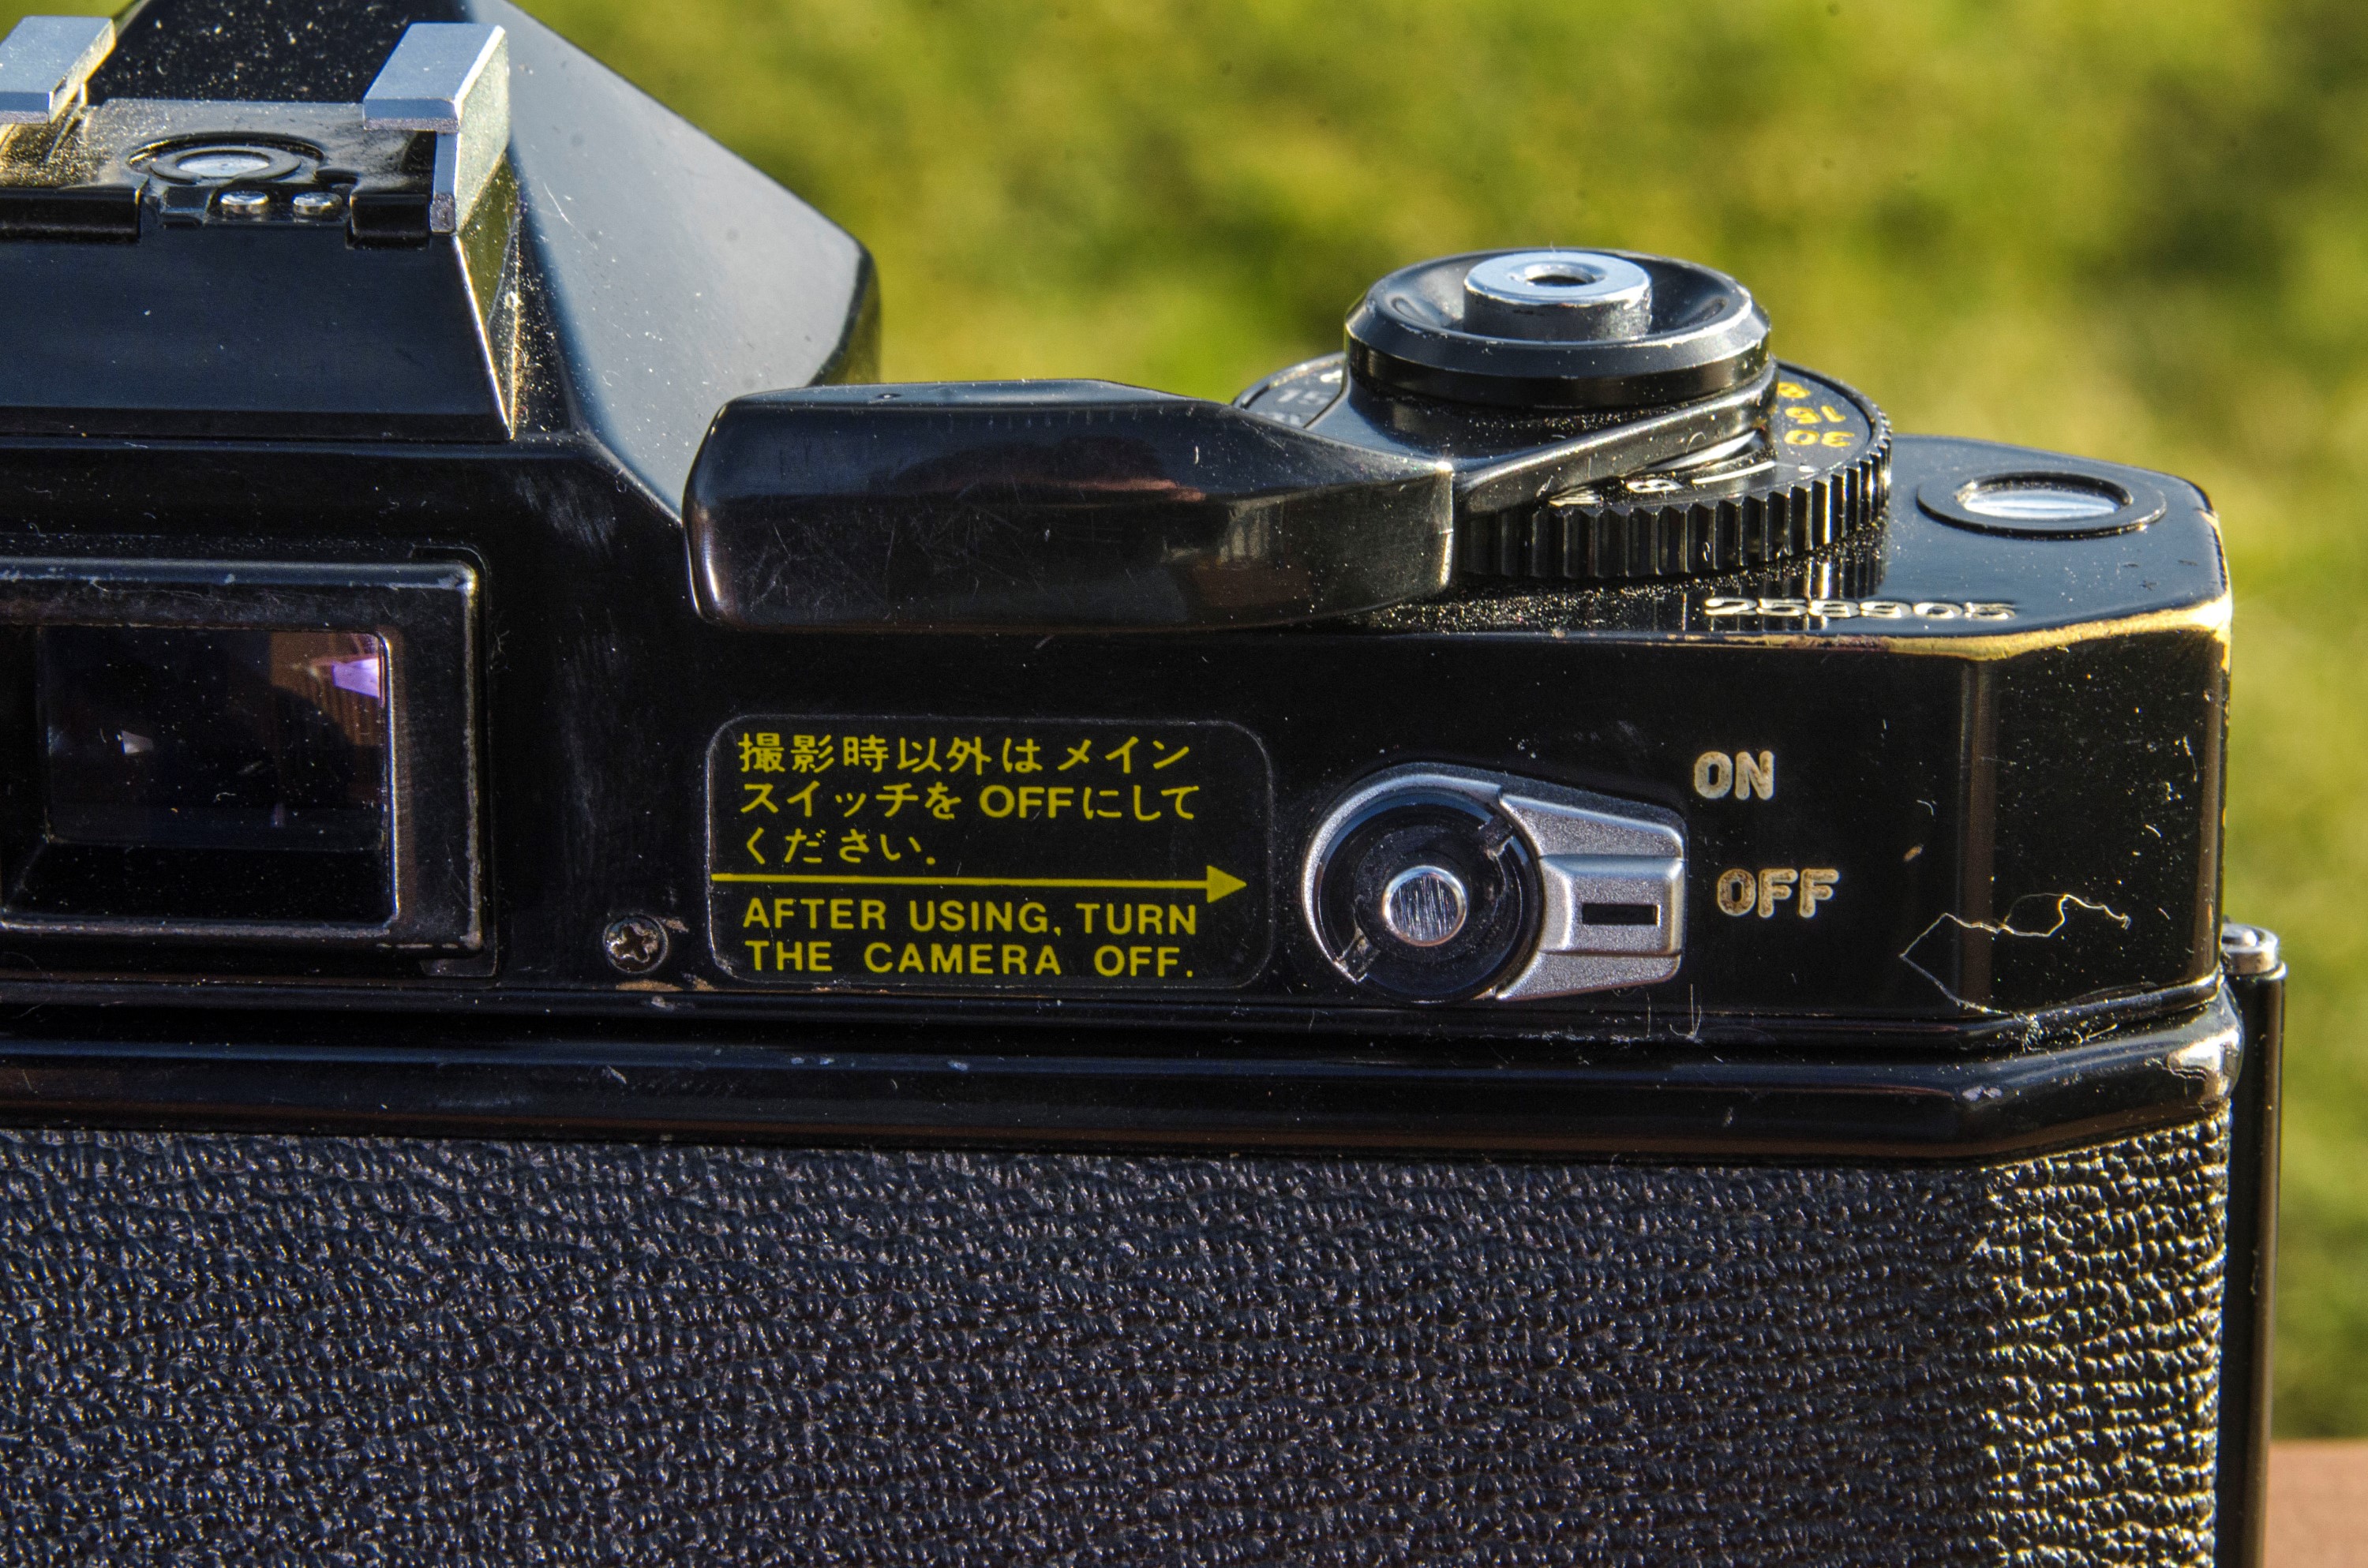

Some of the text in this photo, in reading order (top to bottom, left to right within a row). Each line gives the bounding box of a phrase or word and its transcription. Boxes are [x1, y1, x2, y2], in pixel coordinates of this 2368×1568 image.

[1785, 405, 1847, 425] 15
[1784, 429, 1855, 447] 30
[1703, 597, 2018, 621] 258905
[1694, 750, 1774, 799] ON
[1717, 868, 1839, 918] OFF
[744, 897, 1197, 937] AFTER USING, TURN
[744, 940, 1193, 978] THE CAMERA OFF.
